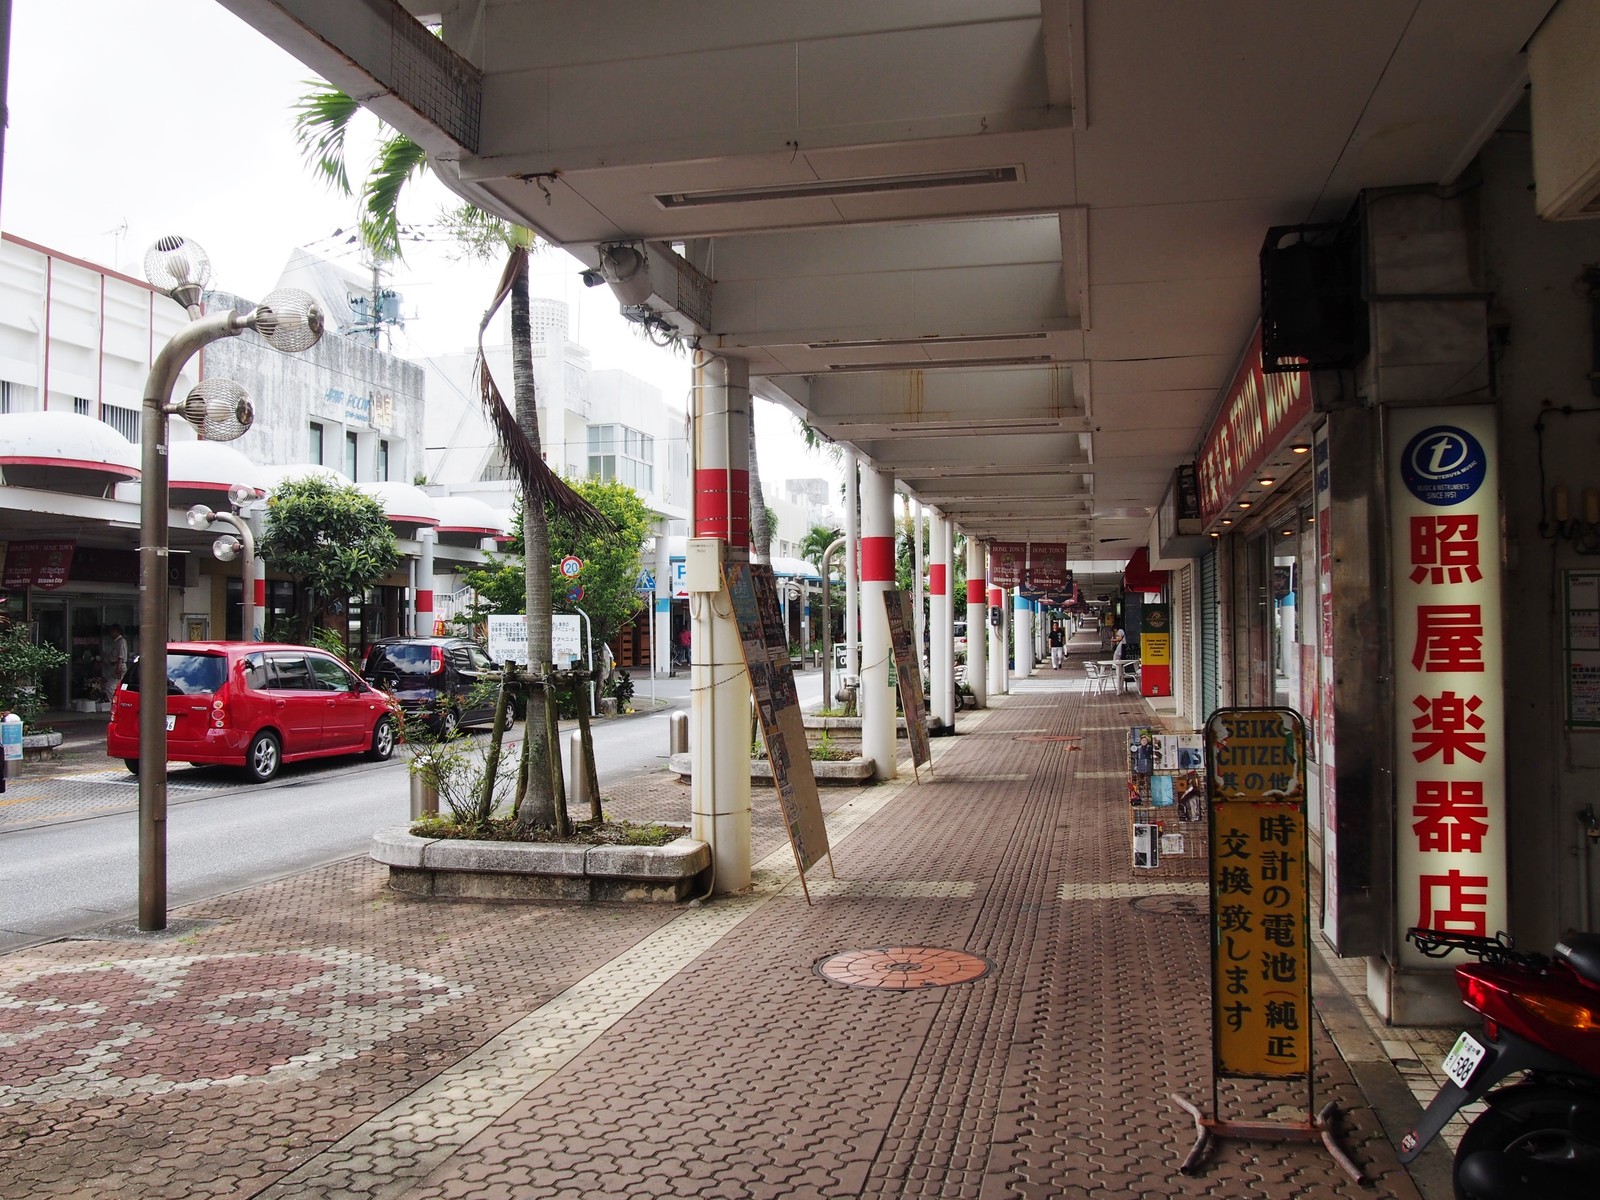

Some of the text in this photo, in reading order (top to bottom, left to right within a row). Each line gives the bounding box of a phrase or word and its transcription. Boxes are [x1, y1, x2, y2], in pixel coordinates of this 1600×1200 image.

[565, 562, 578, 574] 20
[1408, 514, 1489, 942] 照屋楽器店
[1218, 828, 1254, 1033] 交換致します
